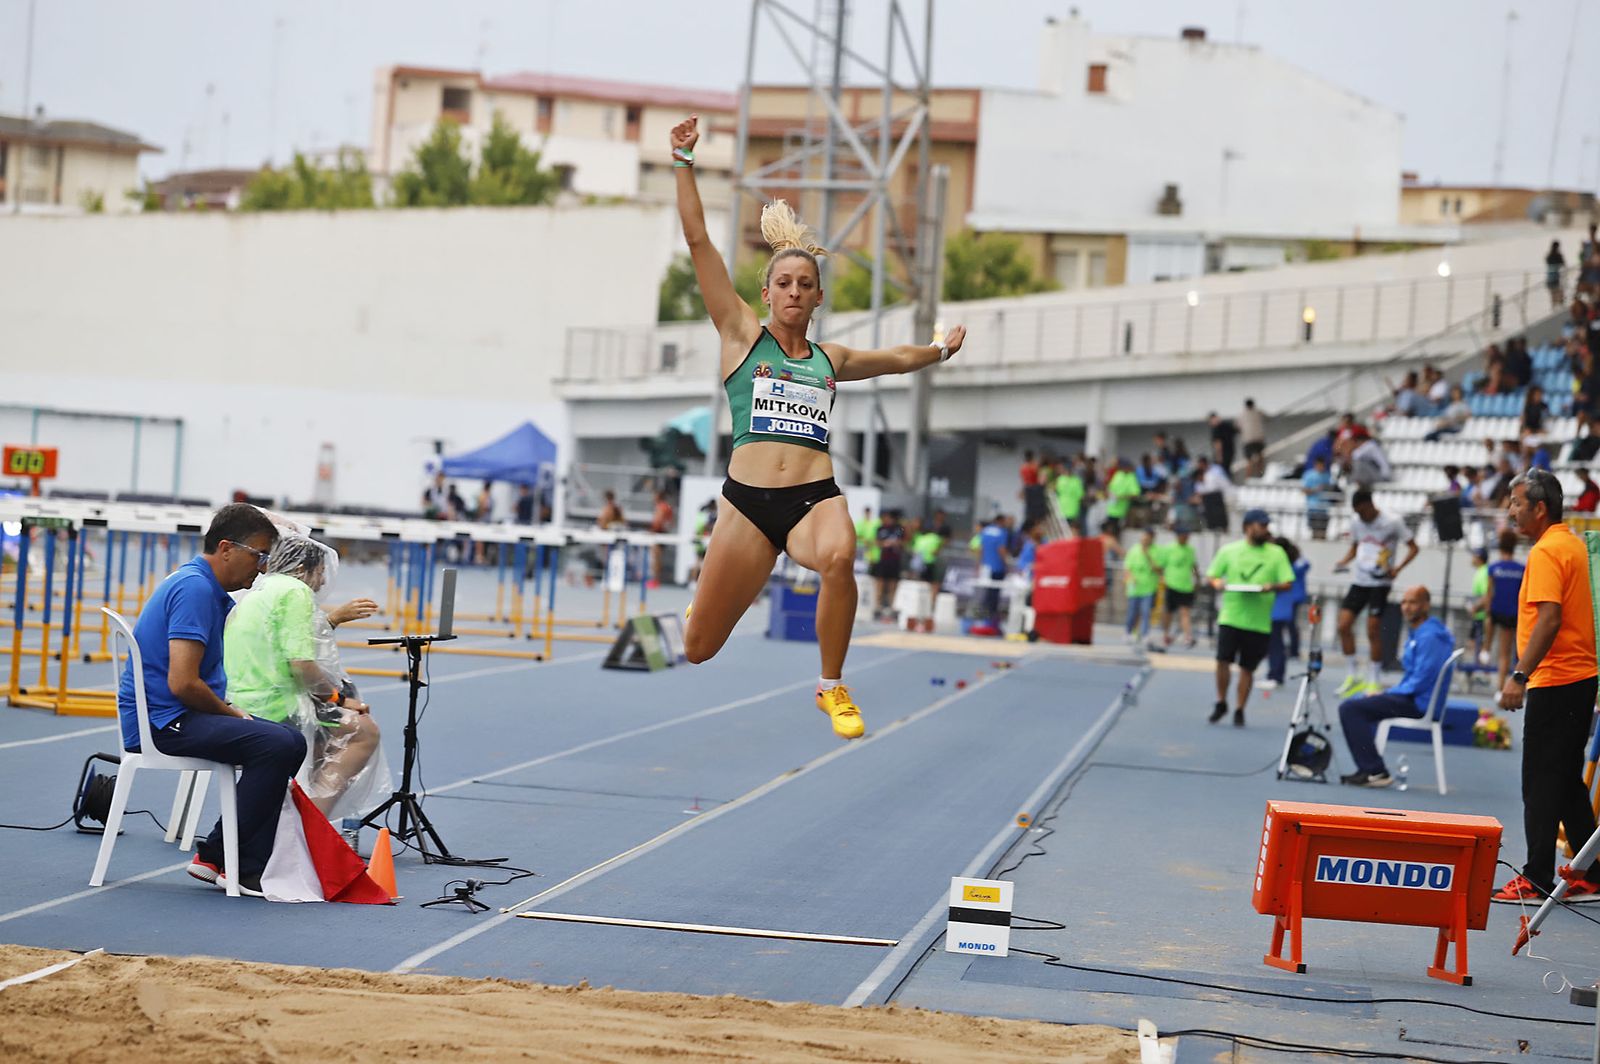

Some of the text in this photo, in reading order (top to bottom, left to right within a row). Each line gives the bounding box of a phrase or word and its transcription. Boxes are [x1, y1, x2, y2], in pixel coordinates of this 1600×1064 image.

[754, 397, 828, 424] MITKOVA
[11, 449, 45, 475] 00
[1316, 857, 1452, 890] MONDO
[958, 942, 996, 951] MONDO
